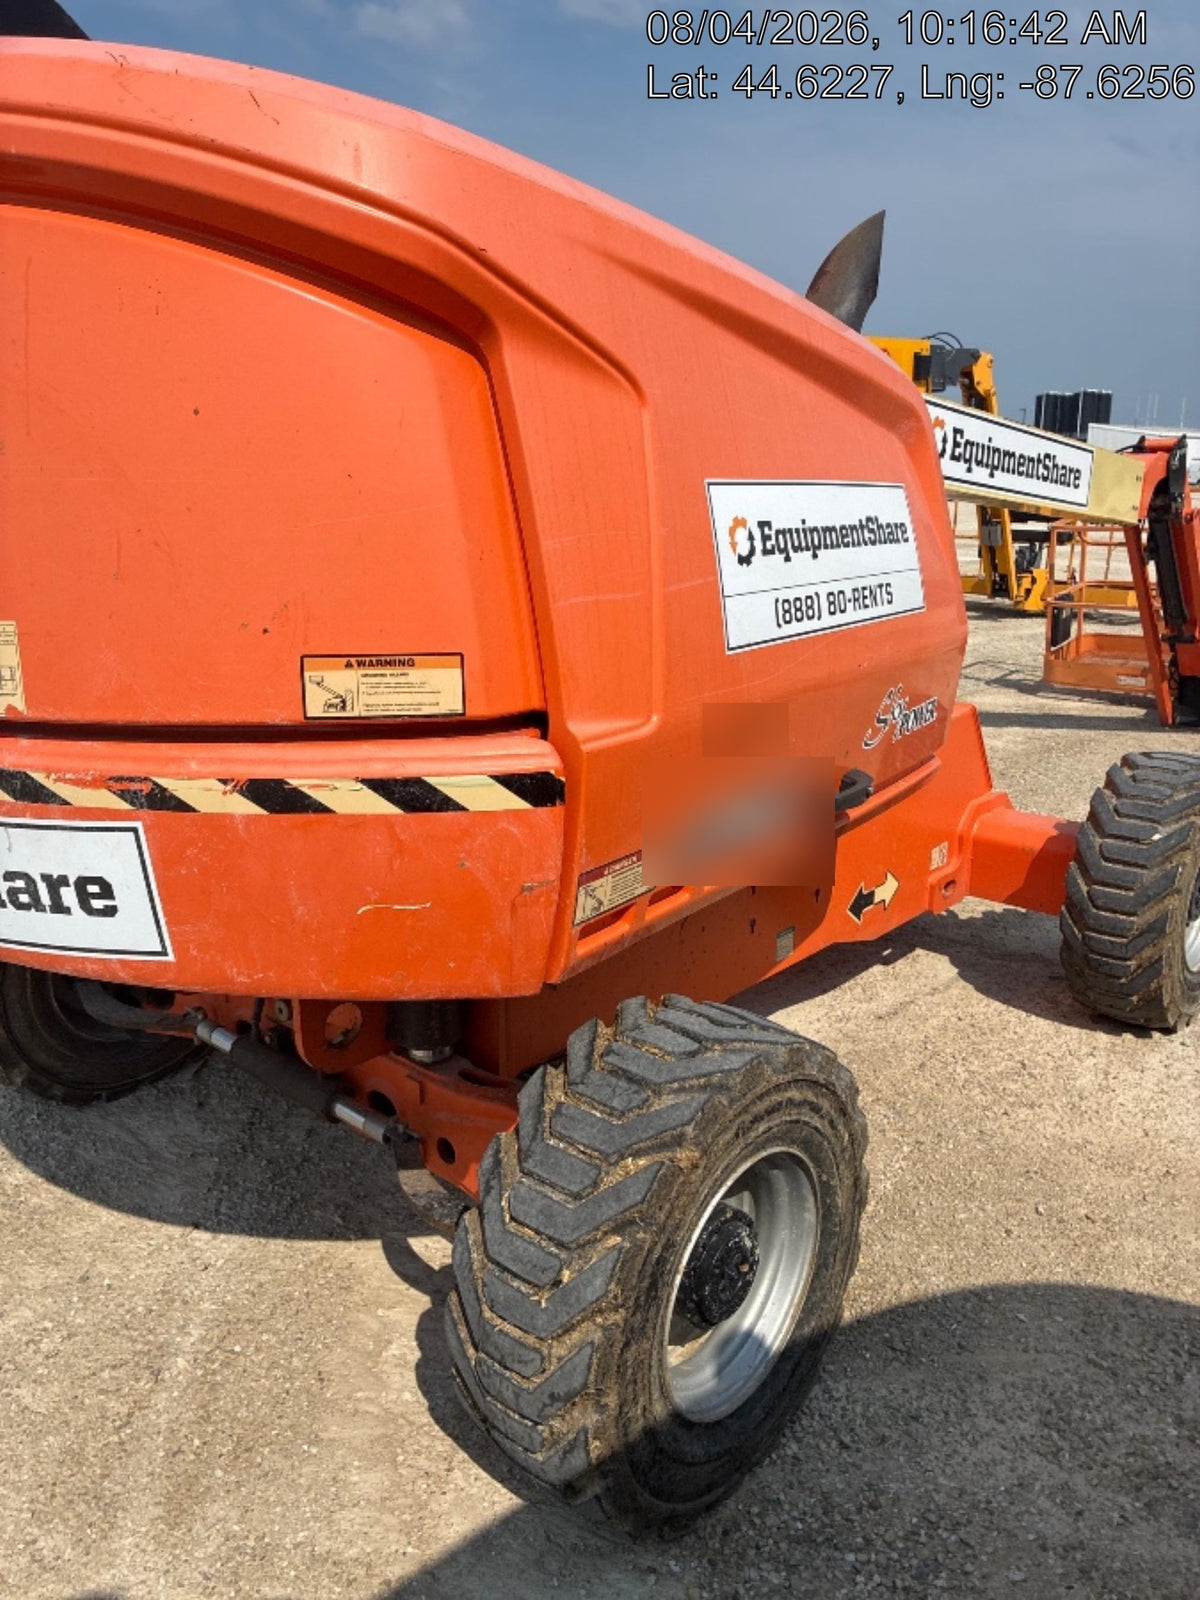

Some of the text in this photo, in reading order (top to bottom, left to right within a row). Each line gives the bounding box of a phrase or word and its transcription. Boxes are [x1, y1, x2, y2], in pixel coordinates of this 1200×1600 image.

[949, 426, 1082, 490] EquipmentShare
[757, 515, 909, 563] EquipmentShare
[774, 582, 894, 629] (888) 80-RENTS
[356, 657, 416, 668] WARNING
[0, 870, 118, 918] are
